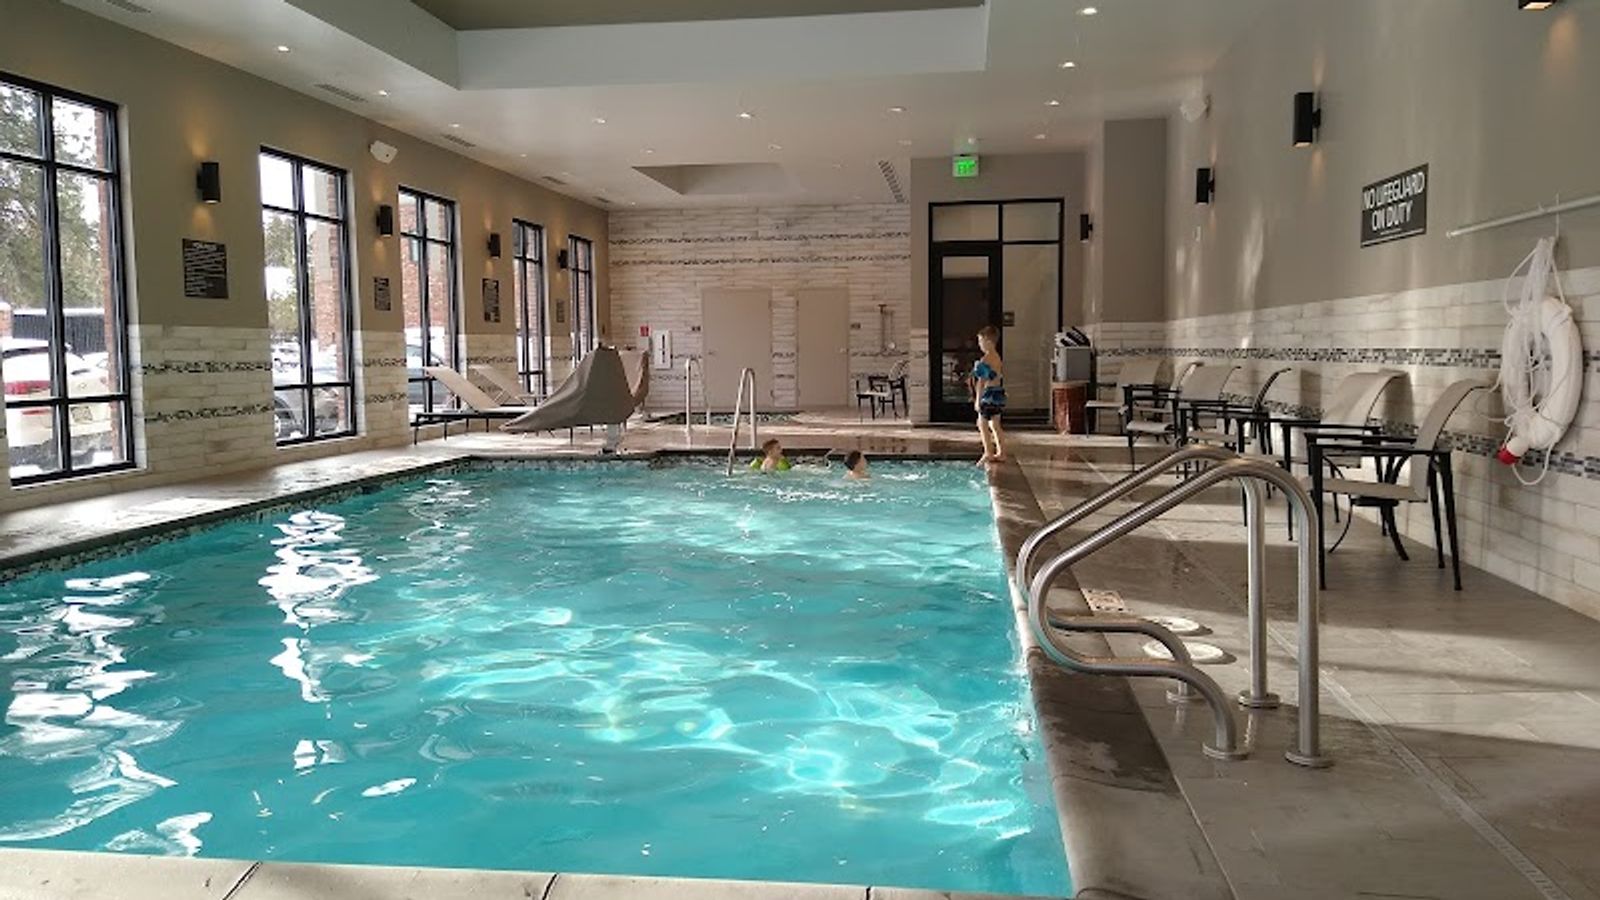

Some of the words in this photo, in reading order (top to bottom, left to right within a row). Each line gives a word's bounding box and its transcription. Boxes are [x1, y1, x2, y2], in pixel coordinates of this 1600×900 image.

[1364, 188, 1375, 209] NO
[1377, 172, 1425, 206] LIFEGUARD
[1372, 208, 1385, 231] ON
[1386, 200, 1413, 227] DUTY
